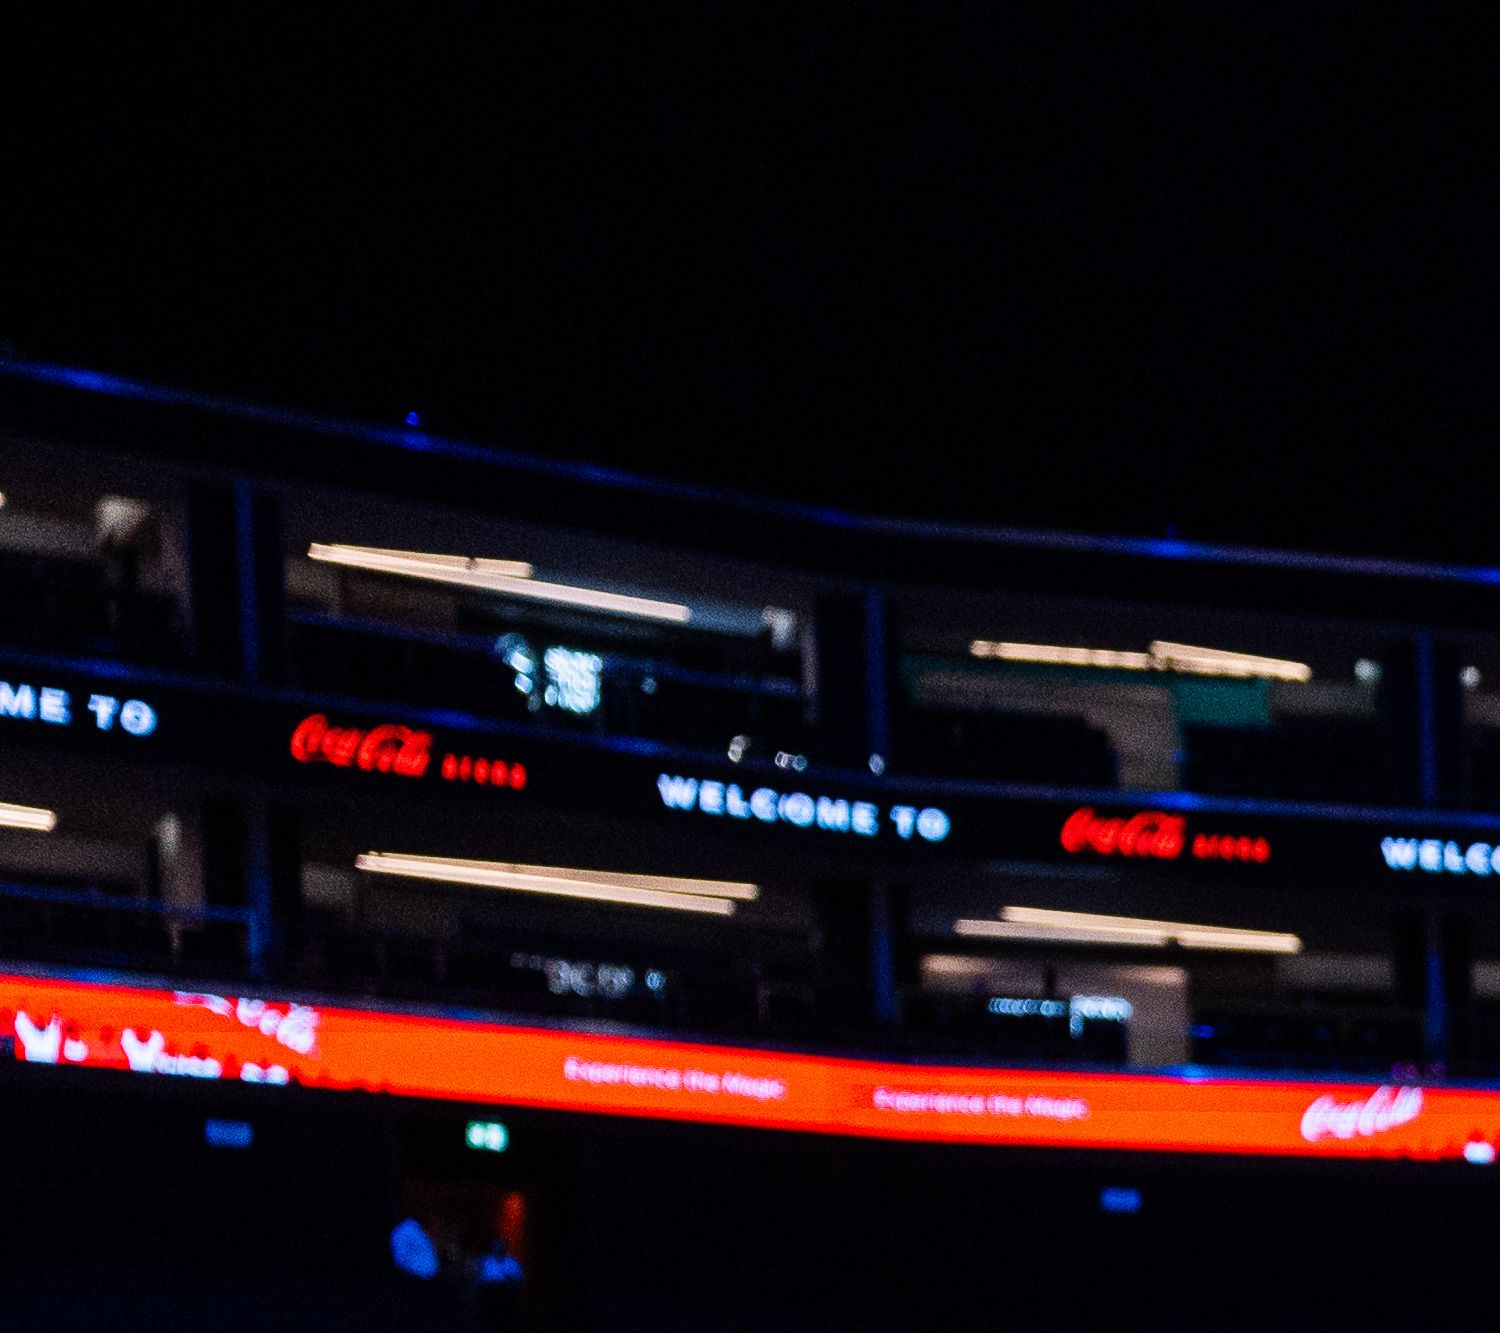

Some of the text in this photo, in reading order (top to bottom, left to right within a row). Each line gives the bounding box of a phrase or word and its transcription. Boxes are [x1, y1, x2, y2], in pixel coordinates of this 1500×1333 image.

[87, 692, 158, 736] TO
[658, 772, 952, 841] WELCOME TO
